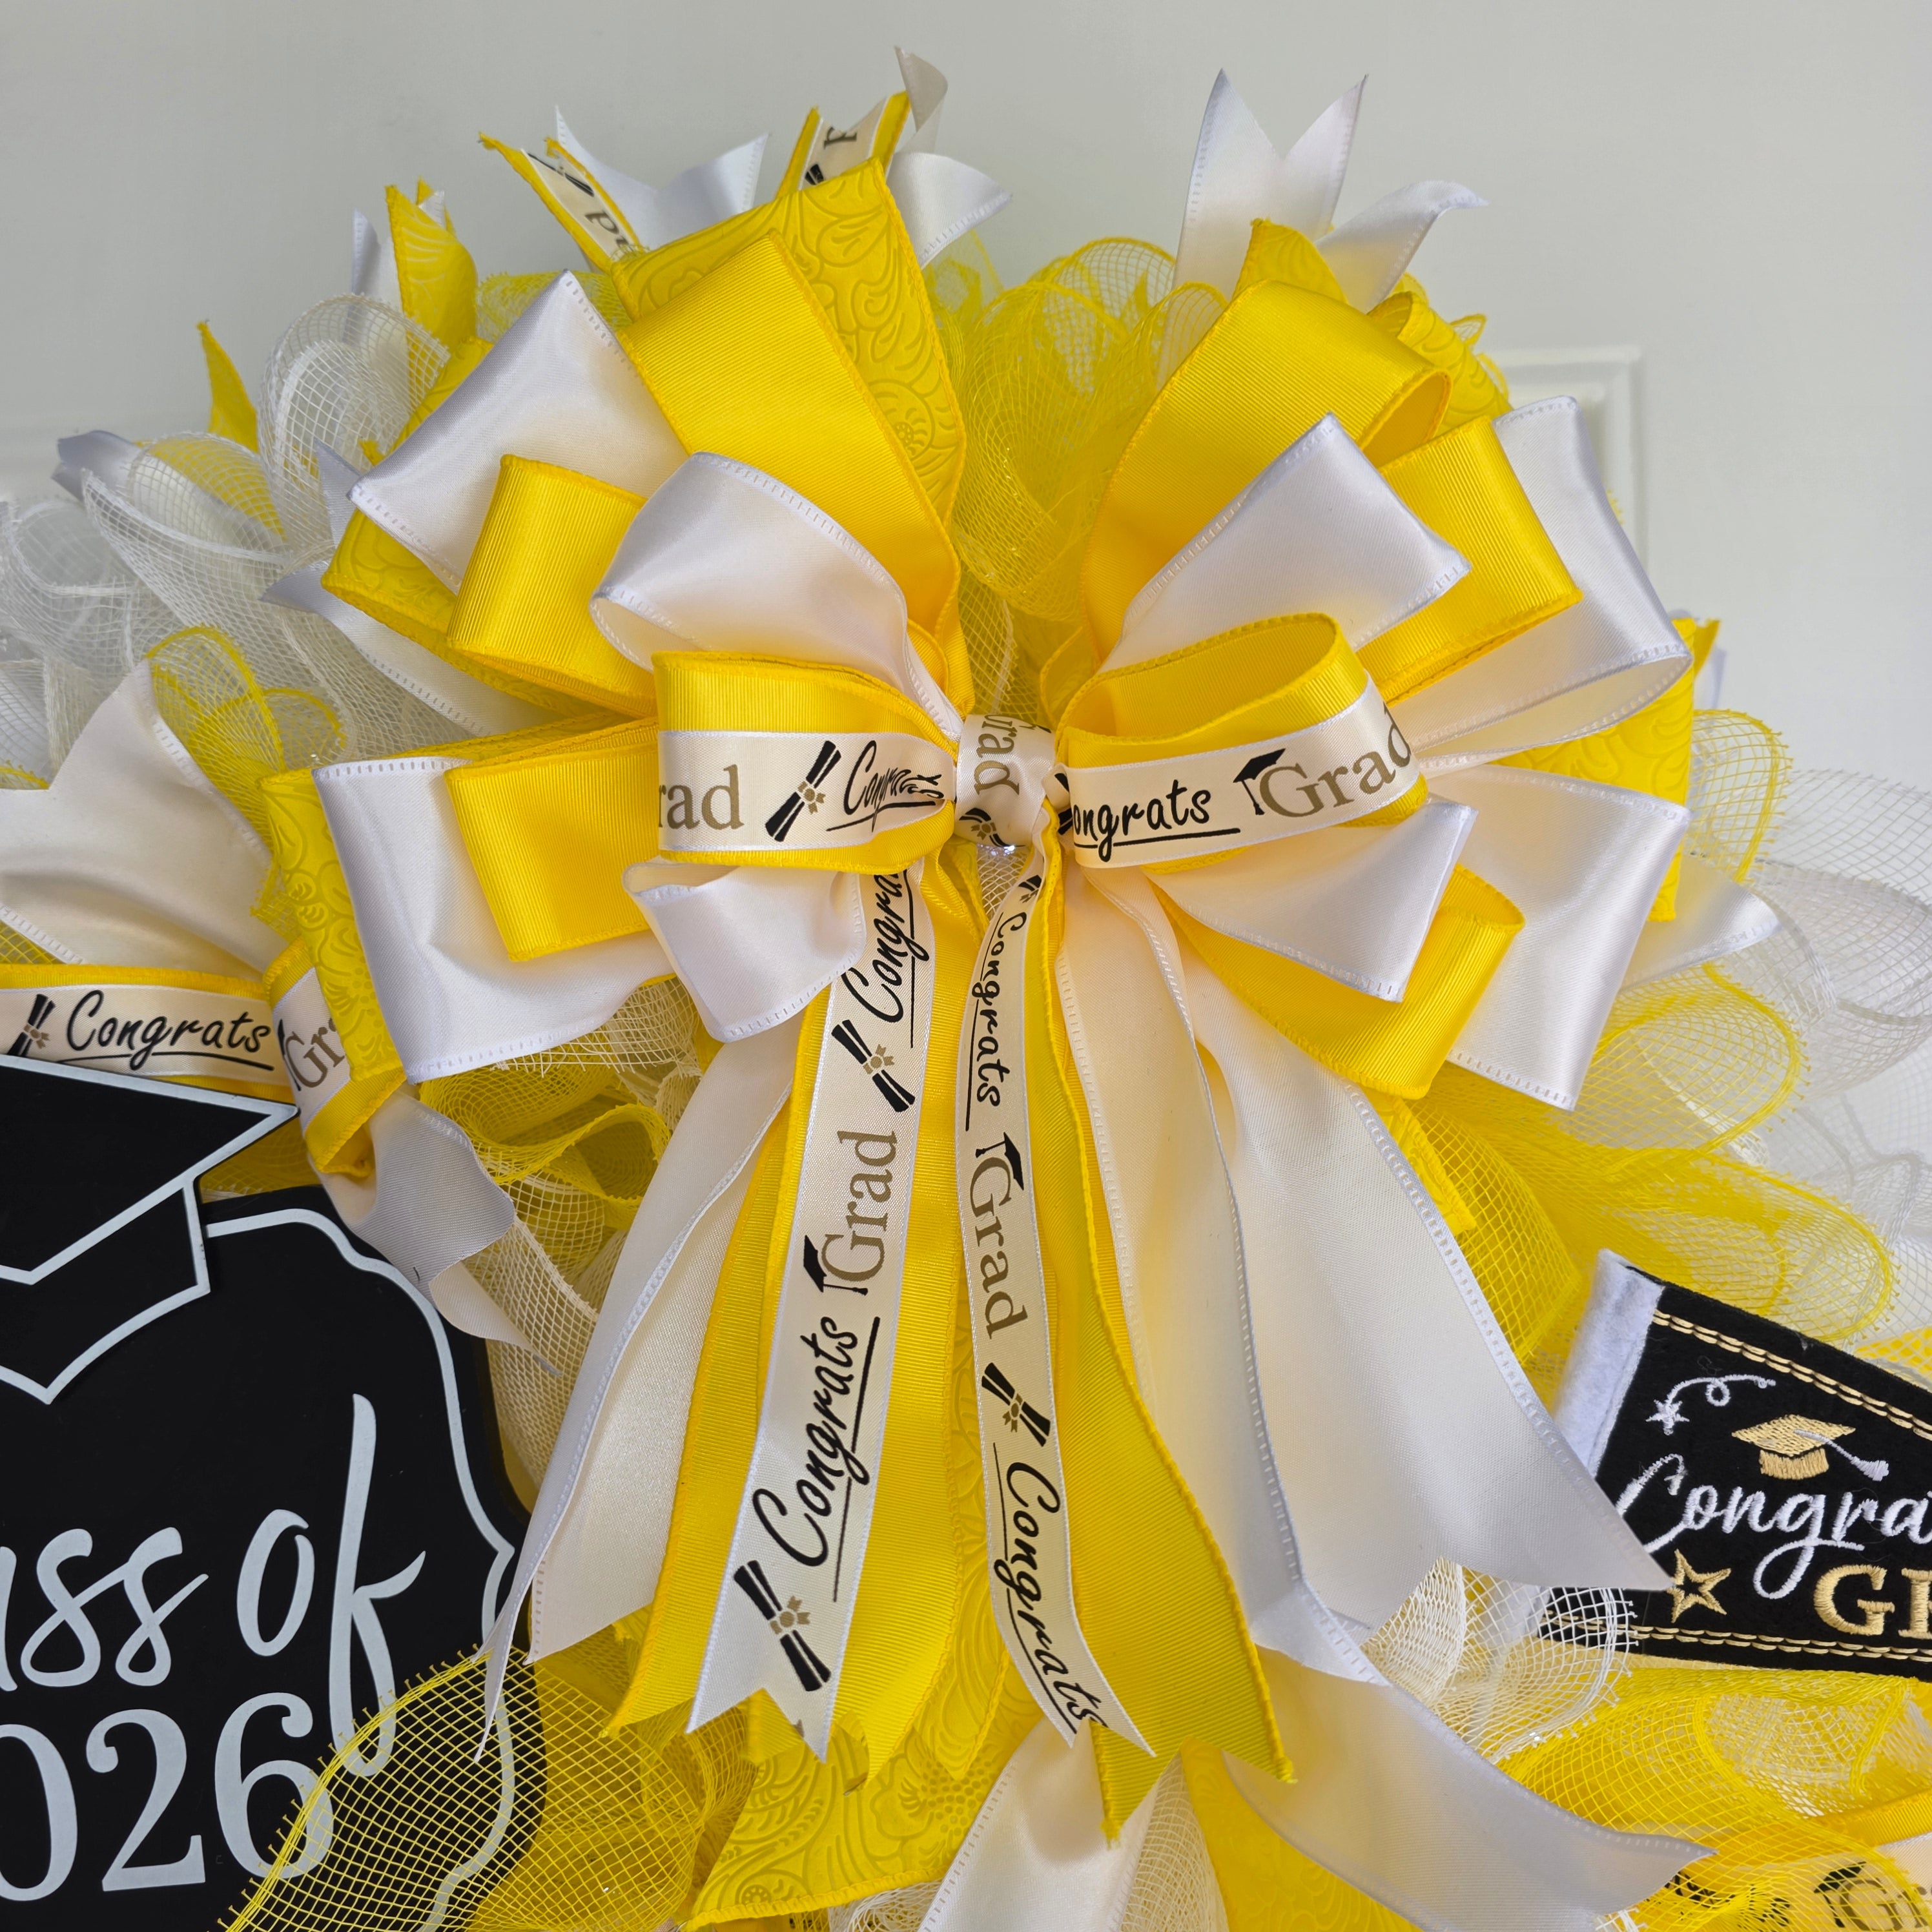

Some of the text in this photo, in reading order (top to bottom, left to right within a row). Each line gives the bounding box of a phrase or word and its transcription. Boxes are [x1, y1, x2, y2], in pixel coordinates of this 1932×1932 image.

[1259, 701, 1412, 818] Grad
[67, 990, 272, 1071] Congrats
[285, 1018, 345, 1088] Gr
[752, 1315, 870, 1567] Congrats
[821, 1131, 898, 1282] Grad
[969, 912, 1108, 1729] Congrats Grad Congrats
[236, 1393, 426, 1778] of
[1618, 1454, 1932, 1599] Congra
